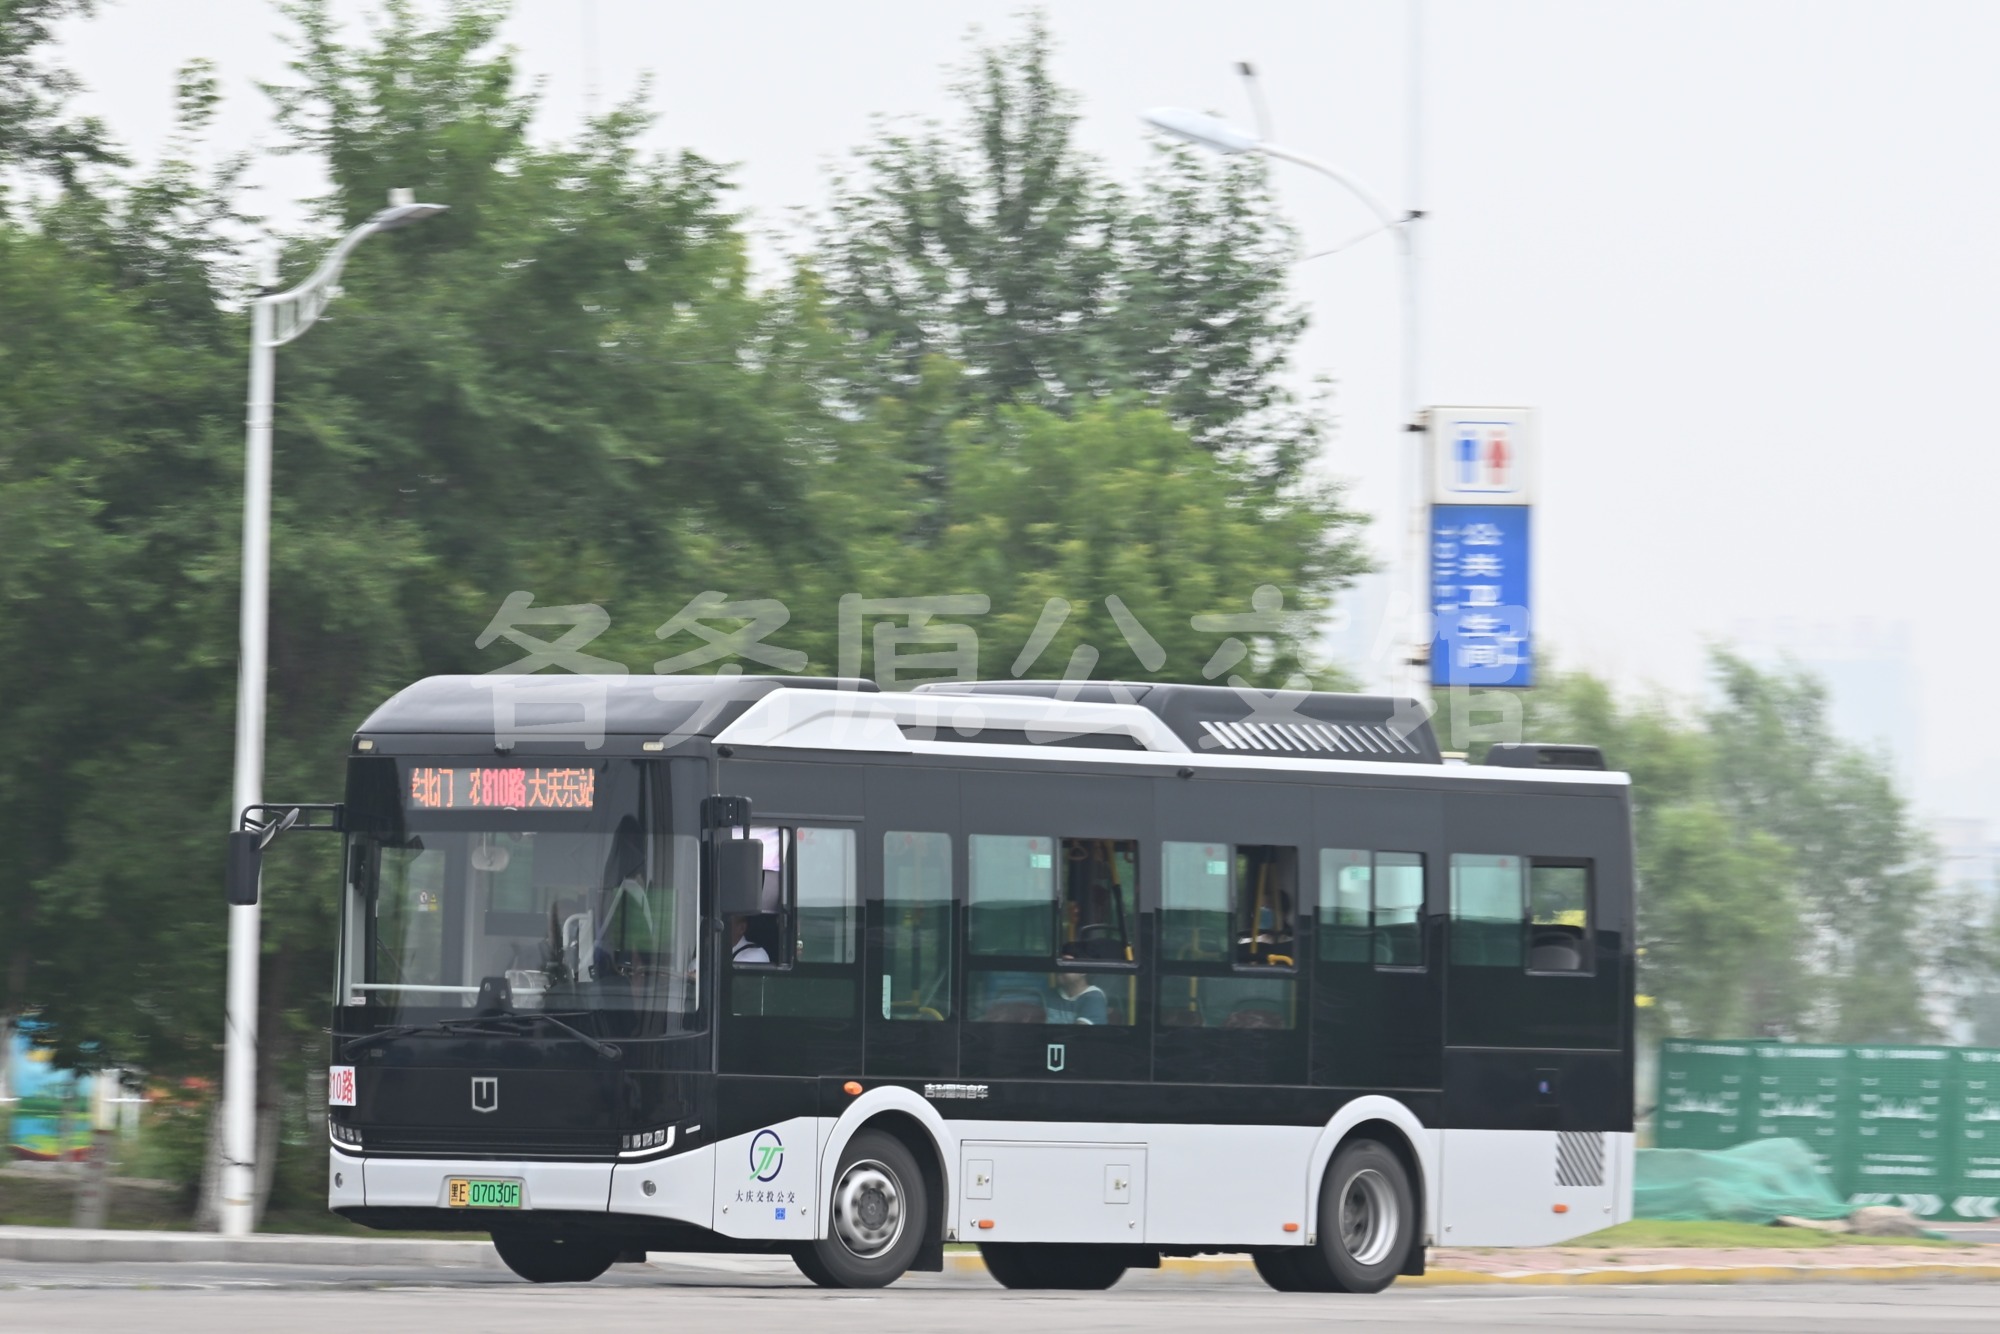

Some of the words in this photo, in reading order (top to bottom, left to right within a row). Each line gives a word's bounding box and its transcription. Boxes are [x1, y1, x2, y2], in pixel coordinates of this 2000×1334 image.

[482, 767, 527, 808] 810路
[528, 767, 595, 808] 大庆东站
[735, 1189, 796, 1204] 大庆交投公交
